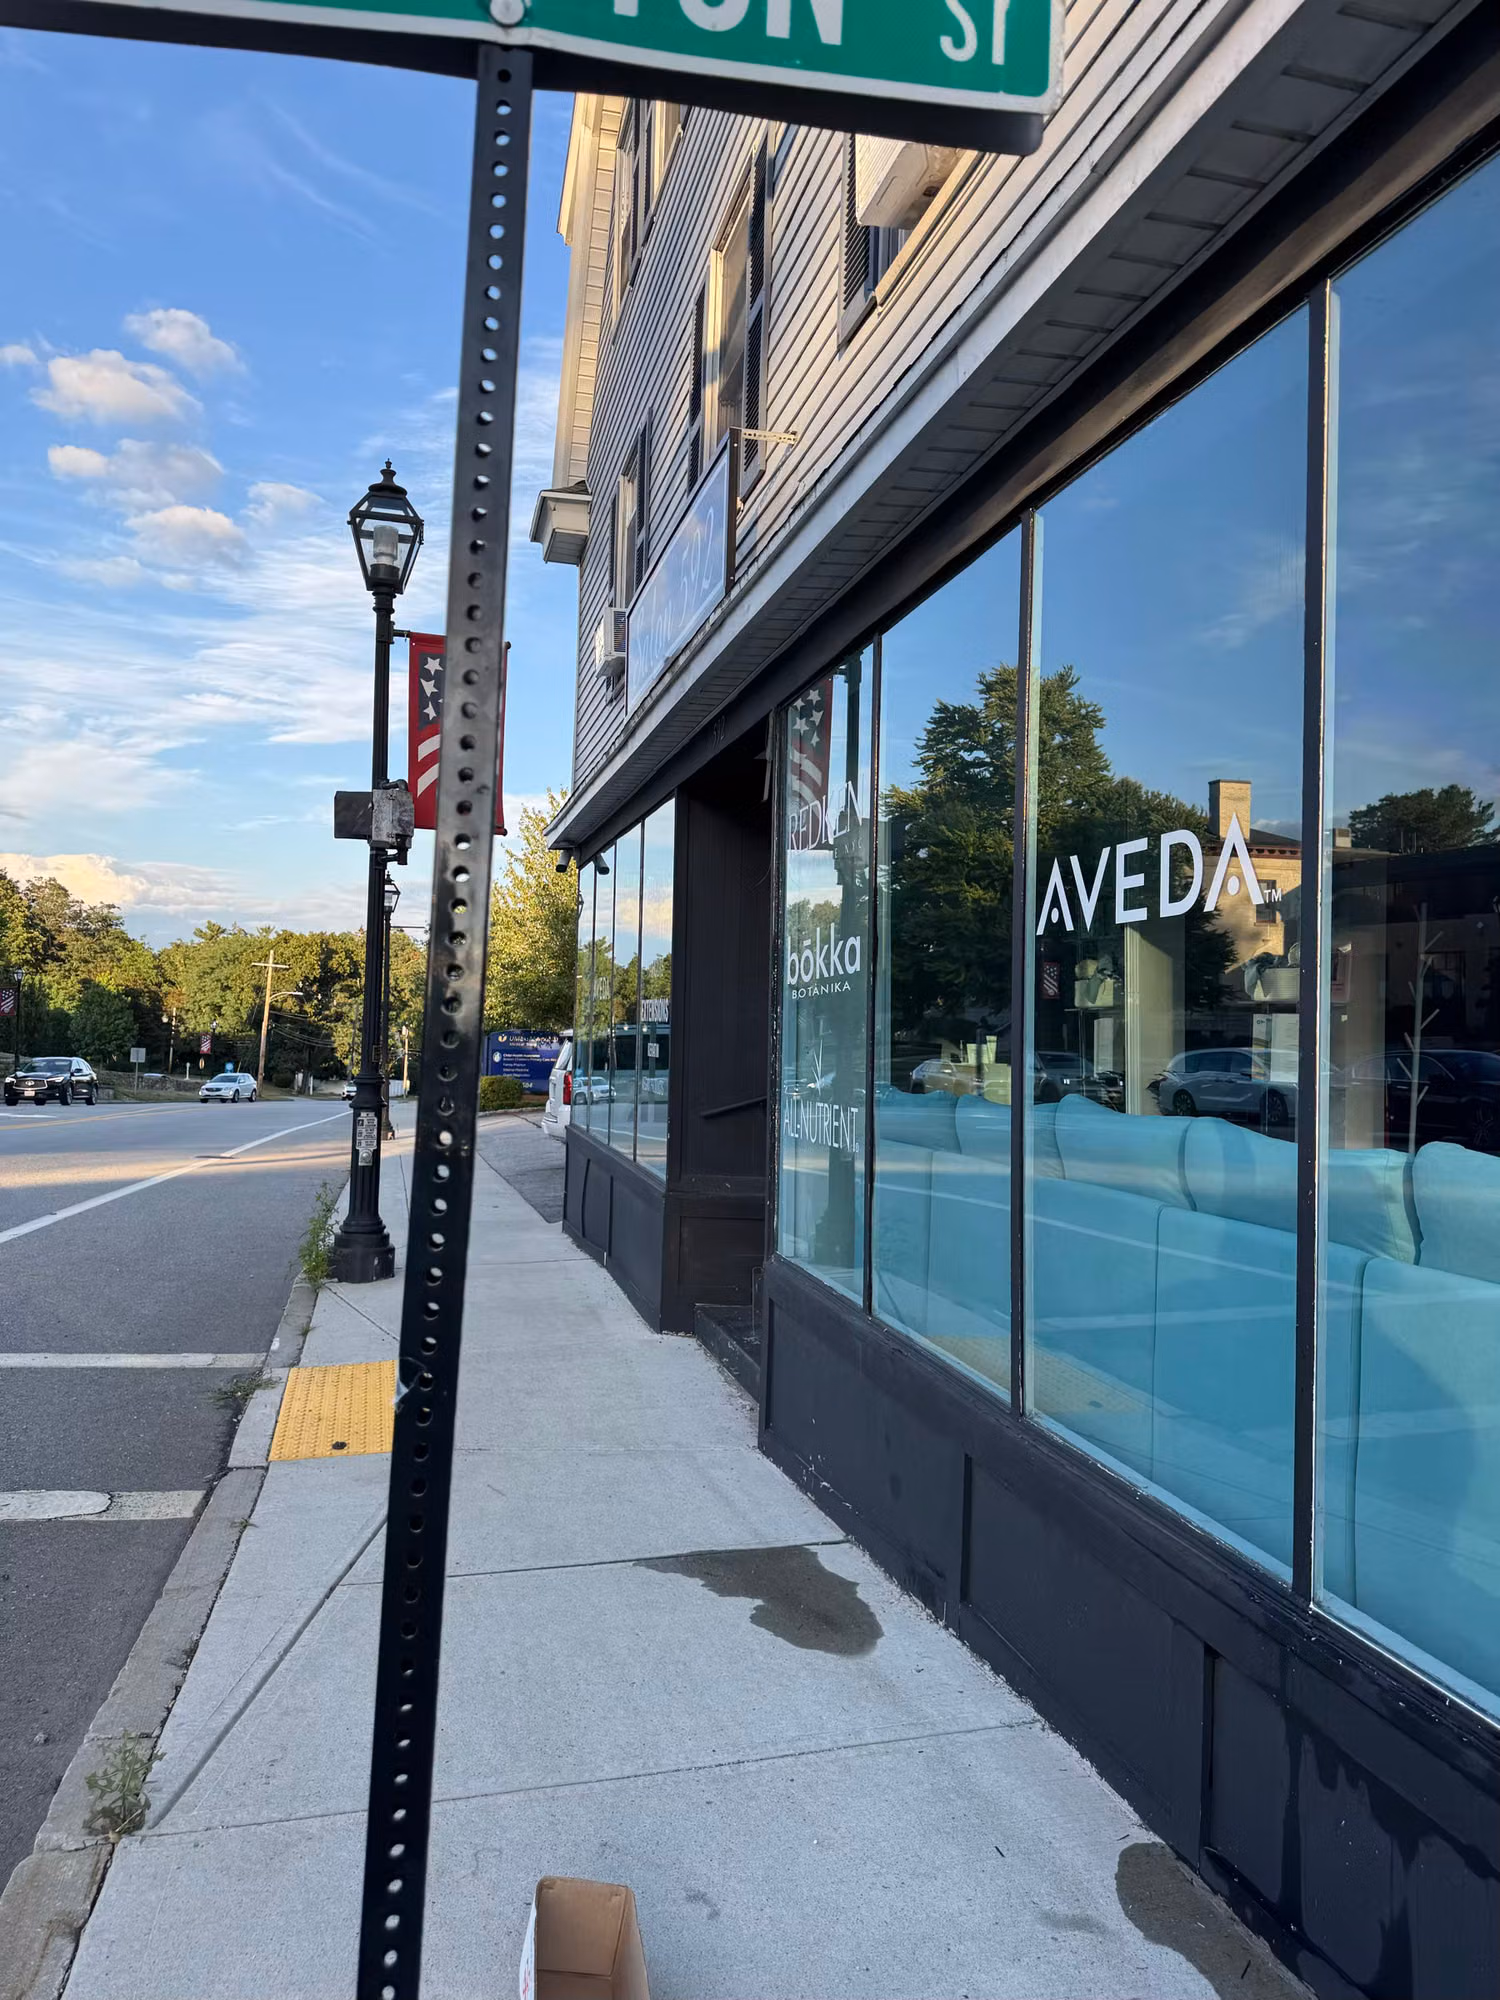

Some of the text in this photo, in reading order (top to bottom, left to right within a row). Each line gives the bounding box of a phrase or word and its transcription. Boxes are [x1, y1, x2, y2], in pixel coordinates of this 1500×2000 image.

[678, 506, 715, 628] 592
[789, 776, 863, 854] REDKEN
[1036, 812, 1264, 936] AVEDA
